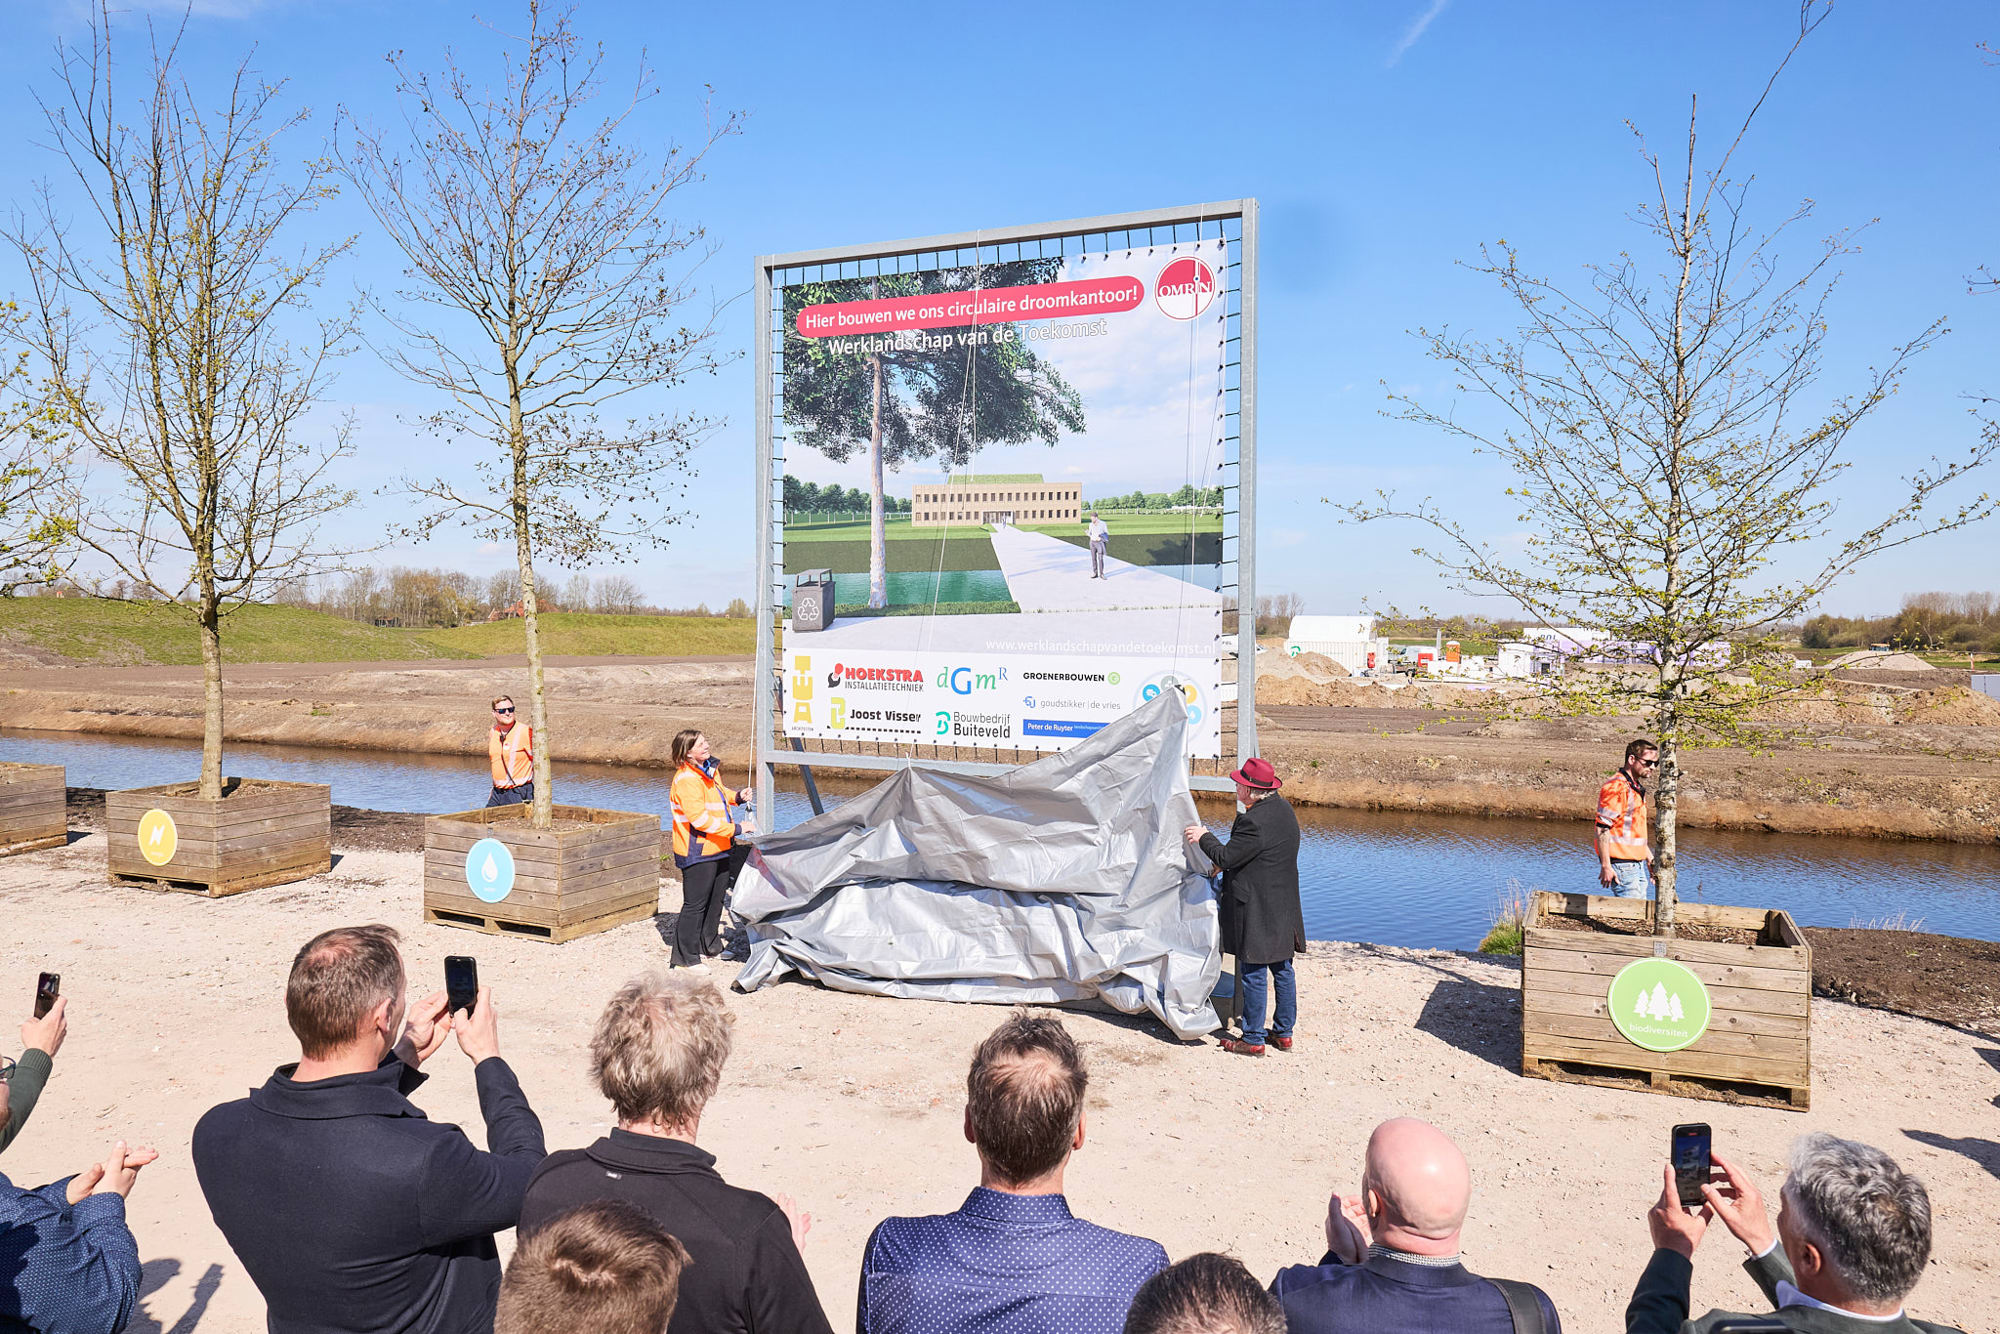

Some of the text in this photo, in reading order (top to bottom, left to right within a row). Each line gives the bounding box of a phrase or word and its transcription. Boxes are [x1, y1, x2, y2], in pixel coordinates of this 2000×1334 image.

[1158, 281, 1213, 297] OMRIN
[806, 285, 1138, 329] Hier bouwen we ons circulaire droomkantoor!
[828, 318, 1107, 355] Werklandschap van de Toekomst
[985, 638, 1217, 655] www.werklandschapvandetoekomst.nl
[845, 667, 924, 682] HOEKSTRA
[1022, 672, 1105, 682] GROENERBOUWEN
[844, 681, 924, 692] INSTALLATIETECHNIEK
[1040, 697, 1085, 709] goudstikker
[1102, 700, 1121, 710] vries
[850, 709, 921, 722] Joost Visser
[954, 711, 1011, 727] Bouwbedrijf
[954, 723, 1011, 738] Buiteveld
[1027, 722, 1043, 731] Peter
[1044, 723, 1053, 731] de
[1053, 724, 1073, 733] Ruyter
